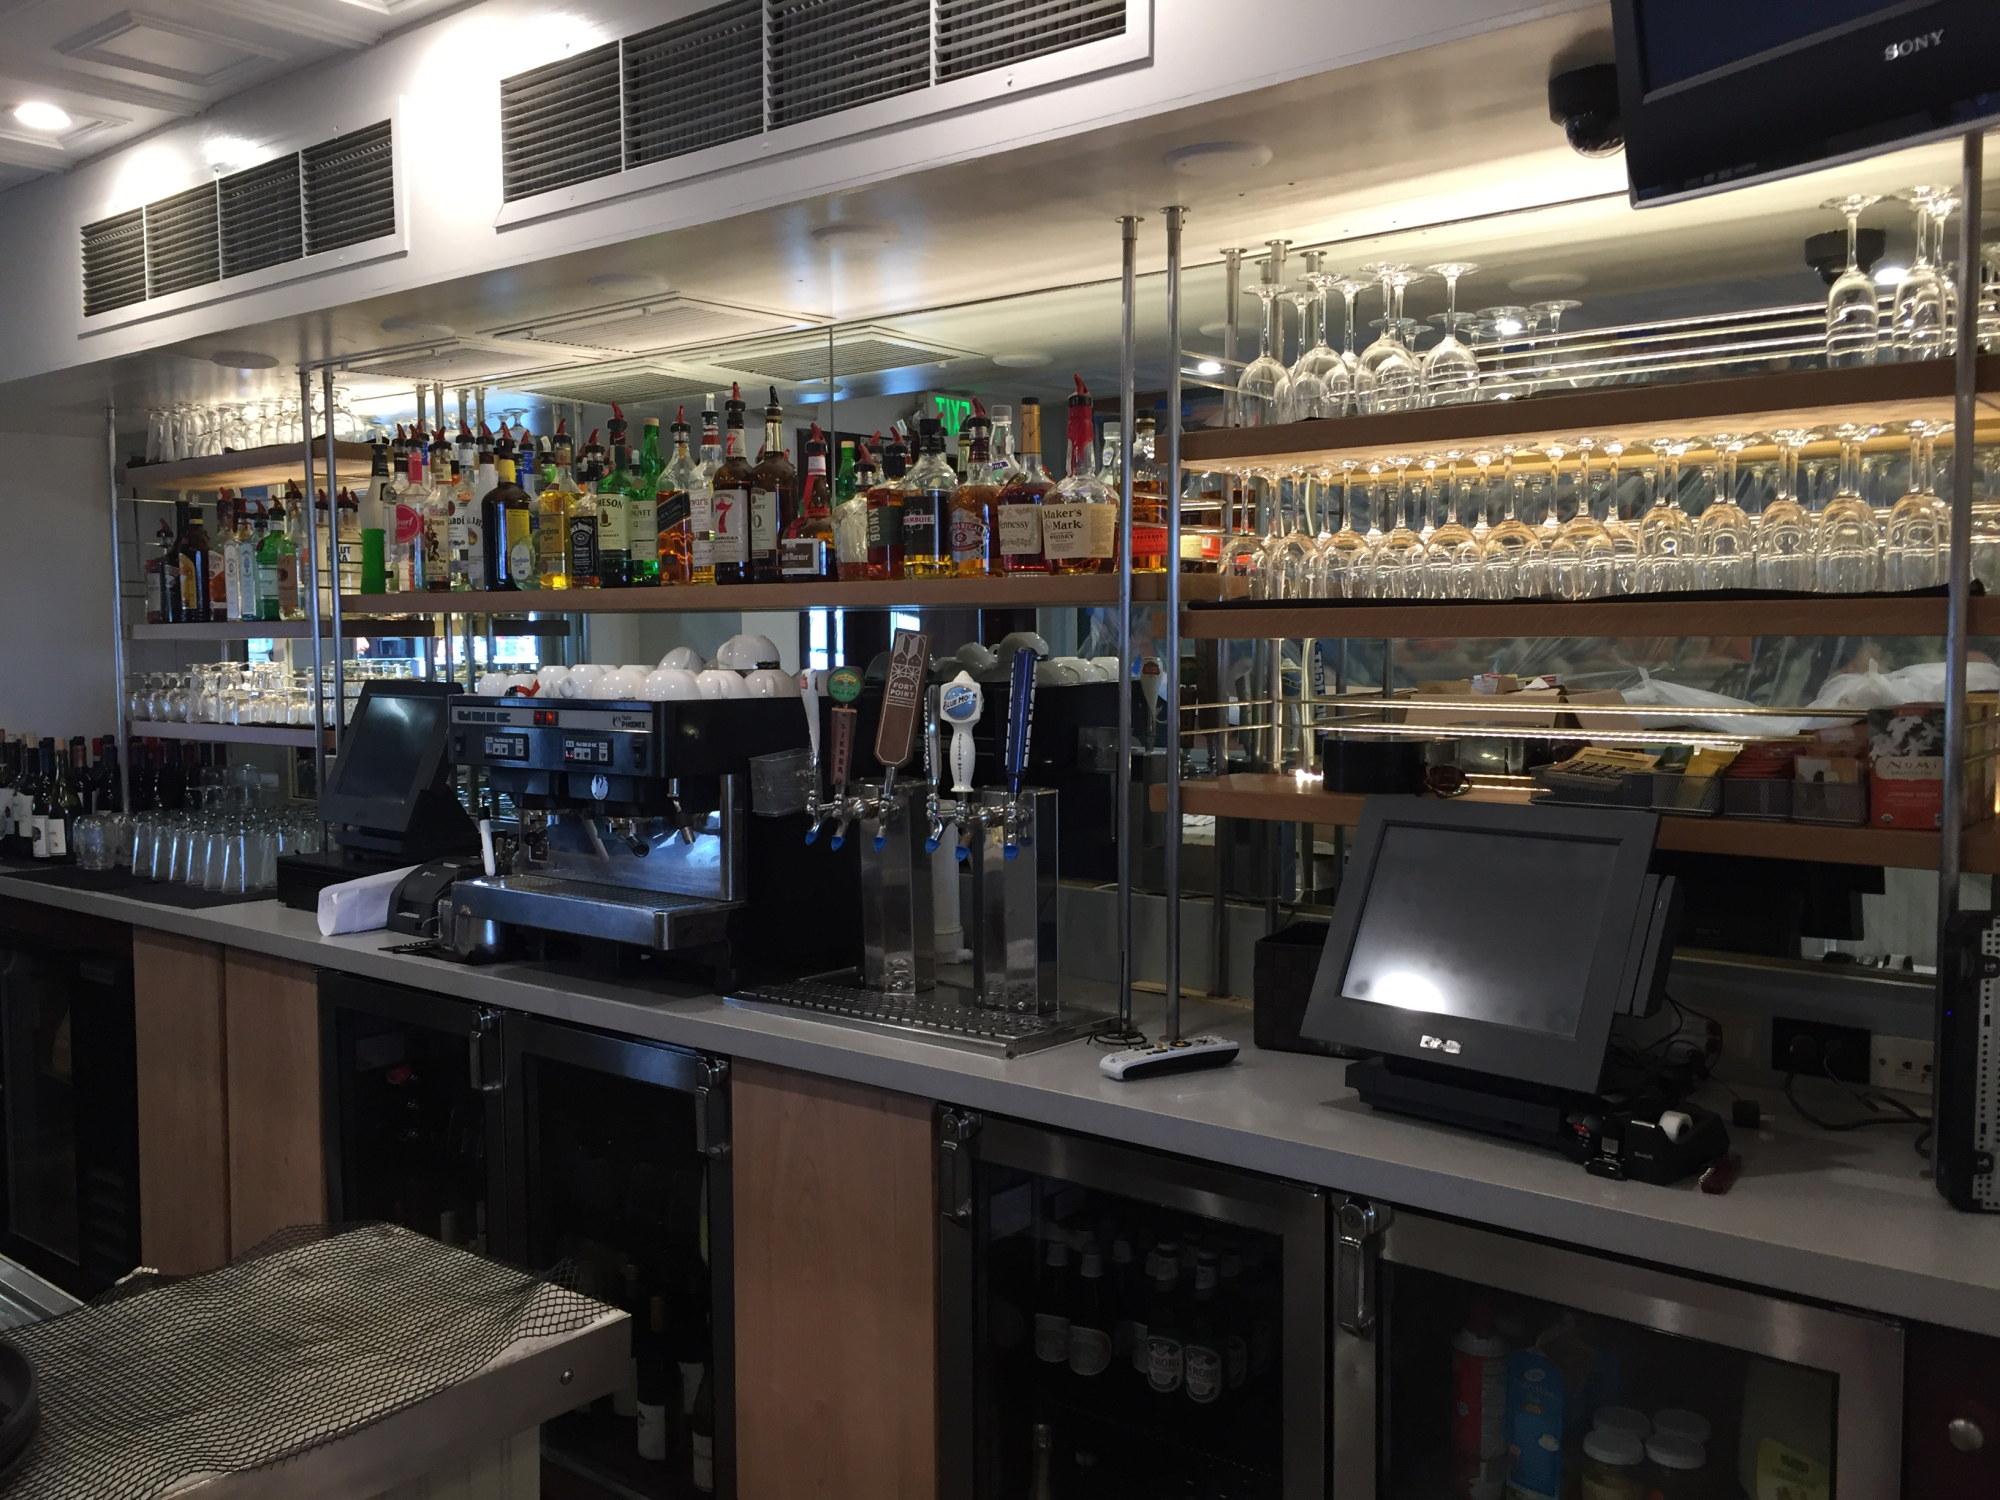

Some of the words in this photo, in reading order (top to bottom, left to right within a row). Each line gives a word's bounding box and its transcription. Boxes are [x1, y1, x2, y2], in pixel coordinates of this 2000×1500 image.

[1884, 28, 1945, 61] SONY
[716, 498, 733, 534] 7
[1043, 509, 1083, 520] Maker's
[868, 508, 881, 542] KNOB
[1052, 519, 1083, 530] Mark
[892, 682, 915, 691] FORT
[890, 688, 915, 699] POINT
[943, 698, 957, 711] BLUE
[837, 723, 847, 773] SIERRA
[1150, 1356, 1180, 1368] ERONI
[1187, 1365, 1218, 1379] ERONI
